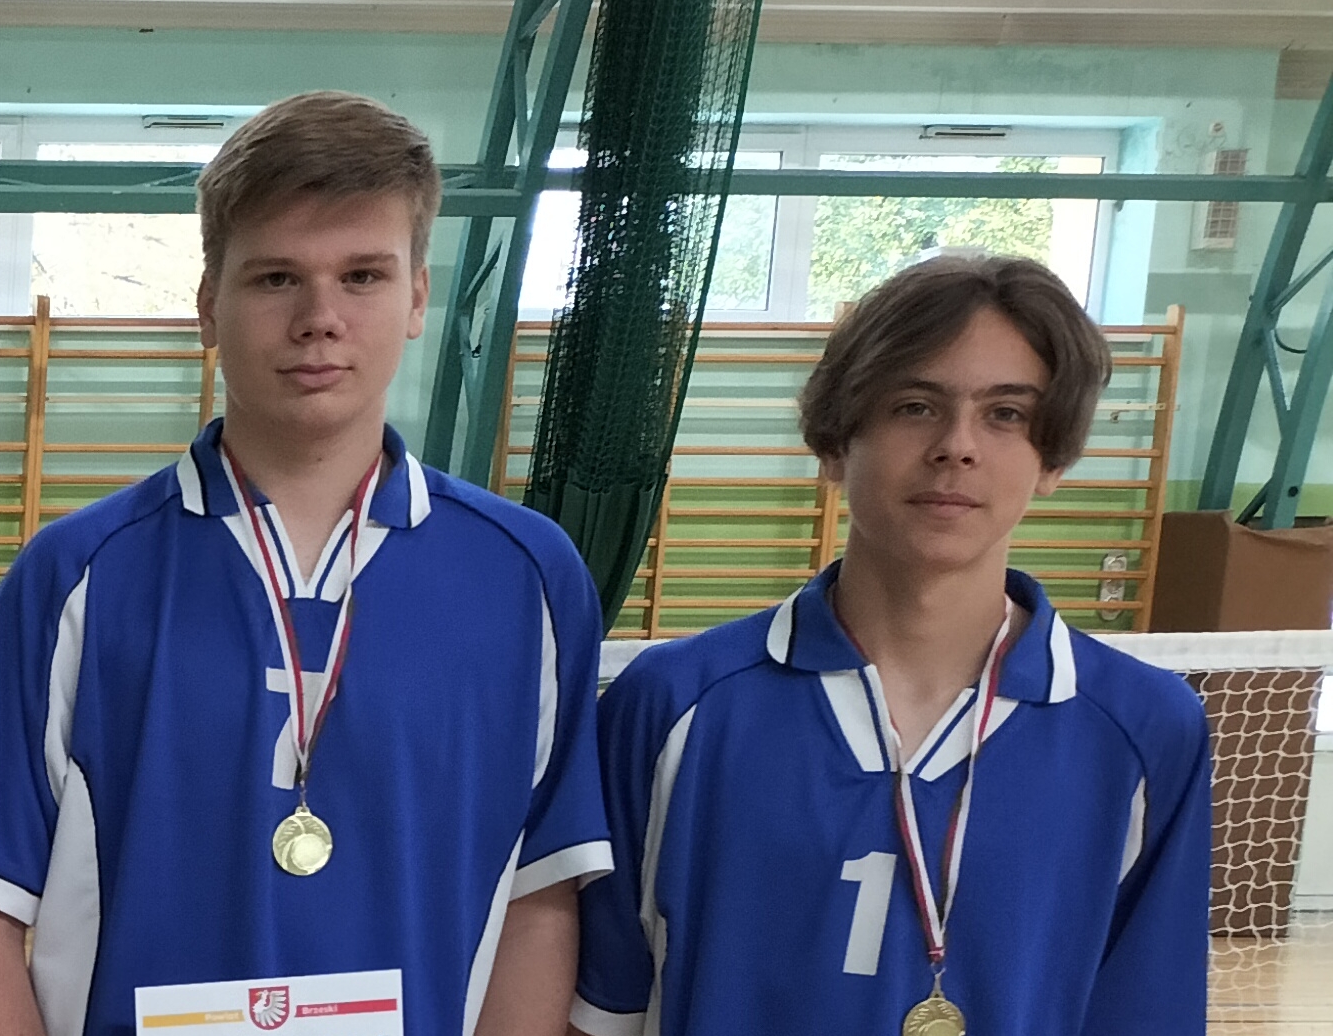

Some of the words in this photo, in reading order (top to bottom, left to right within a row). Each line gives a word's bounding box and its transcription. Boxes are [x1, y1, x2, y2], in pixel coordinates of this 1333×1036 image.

[840, 851, 897, 976] 1
[204, 1012, 240, 1022] Powiat
[301, 1004, 338, 1015] Brzeski
